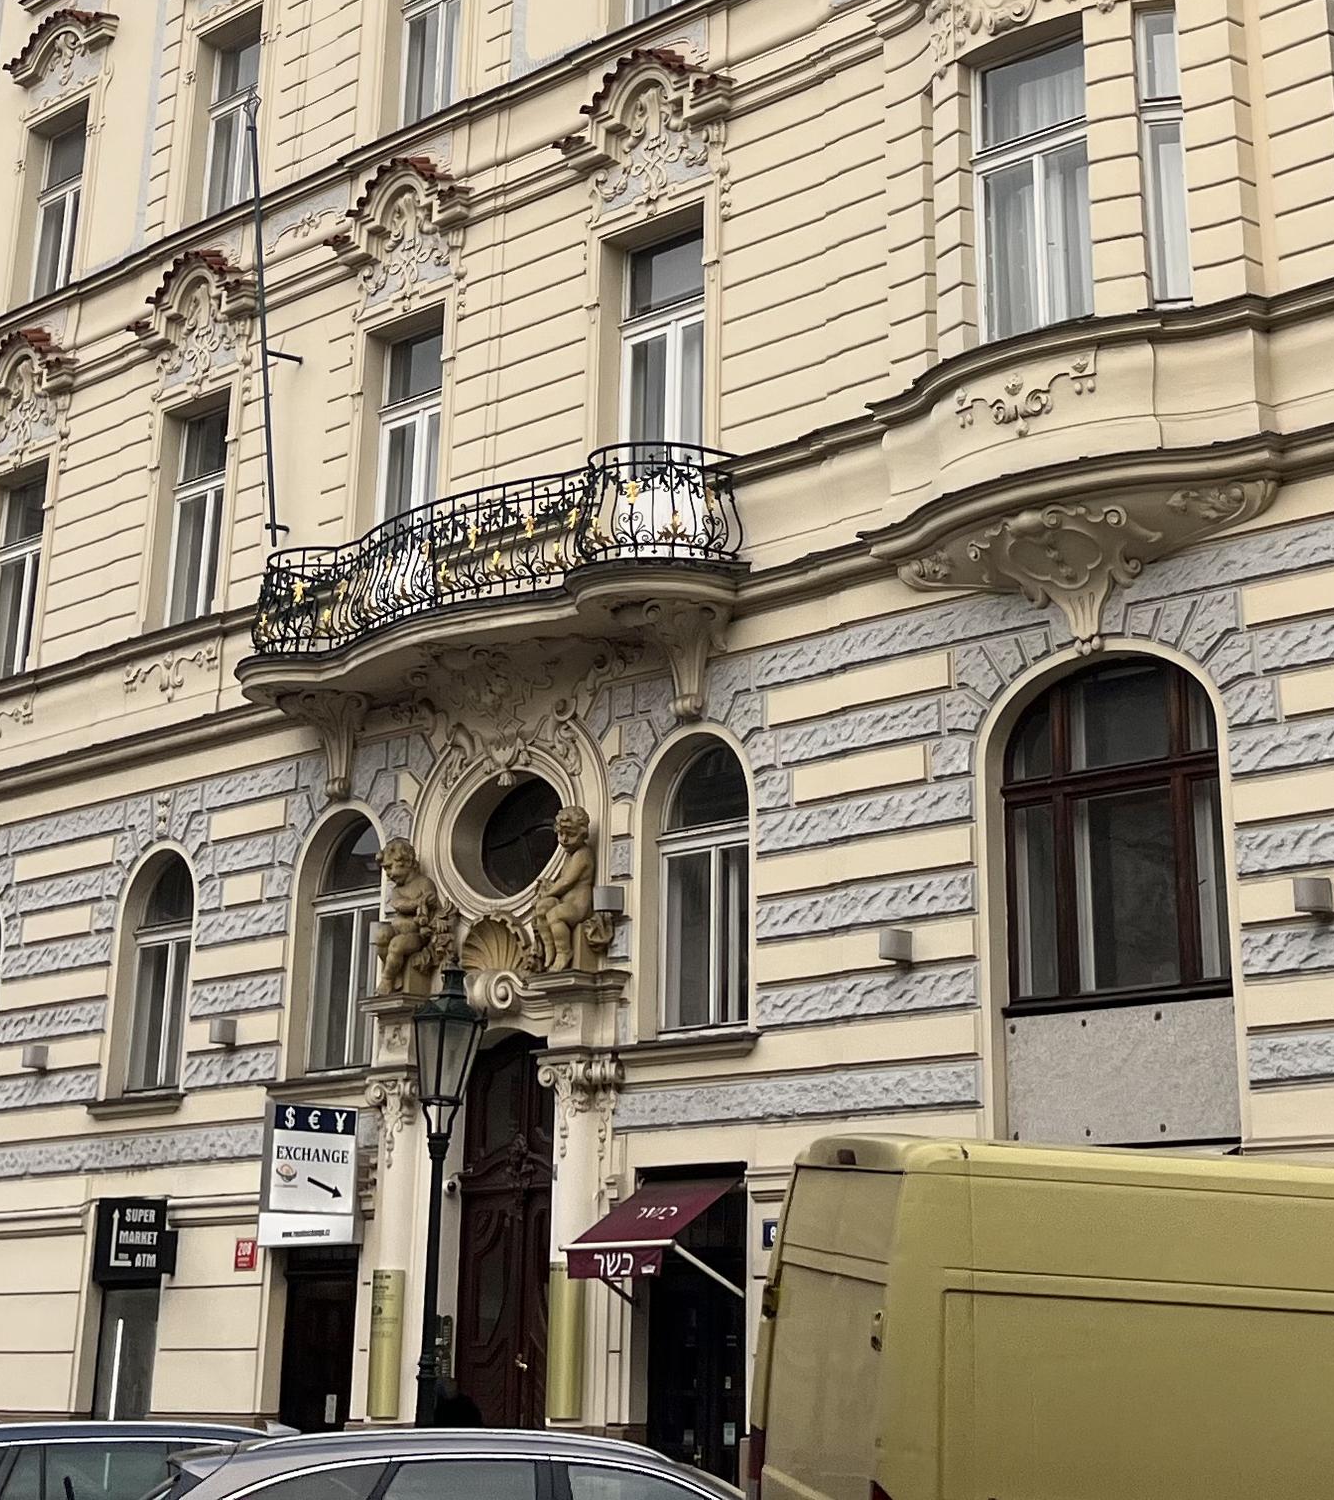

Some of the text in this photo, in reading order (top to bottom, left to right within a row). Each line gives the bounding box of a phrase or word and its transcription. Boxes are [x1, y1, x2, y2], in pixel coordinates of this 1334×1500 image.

[275, 1145, 350, 1165] EXCHANGE
[125, 1208, 156, 1223] SUPER
[118, 1230, 159, 1246] MARKET
[134, 1253, 157, 1268] ATM
[593, 1252, 634, 1277] כשר
